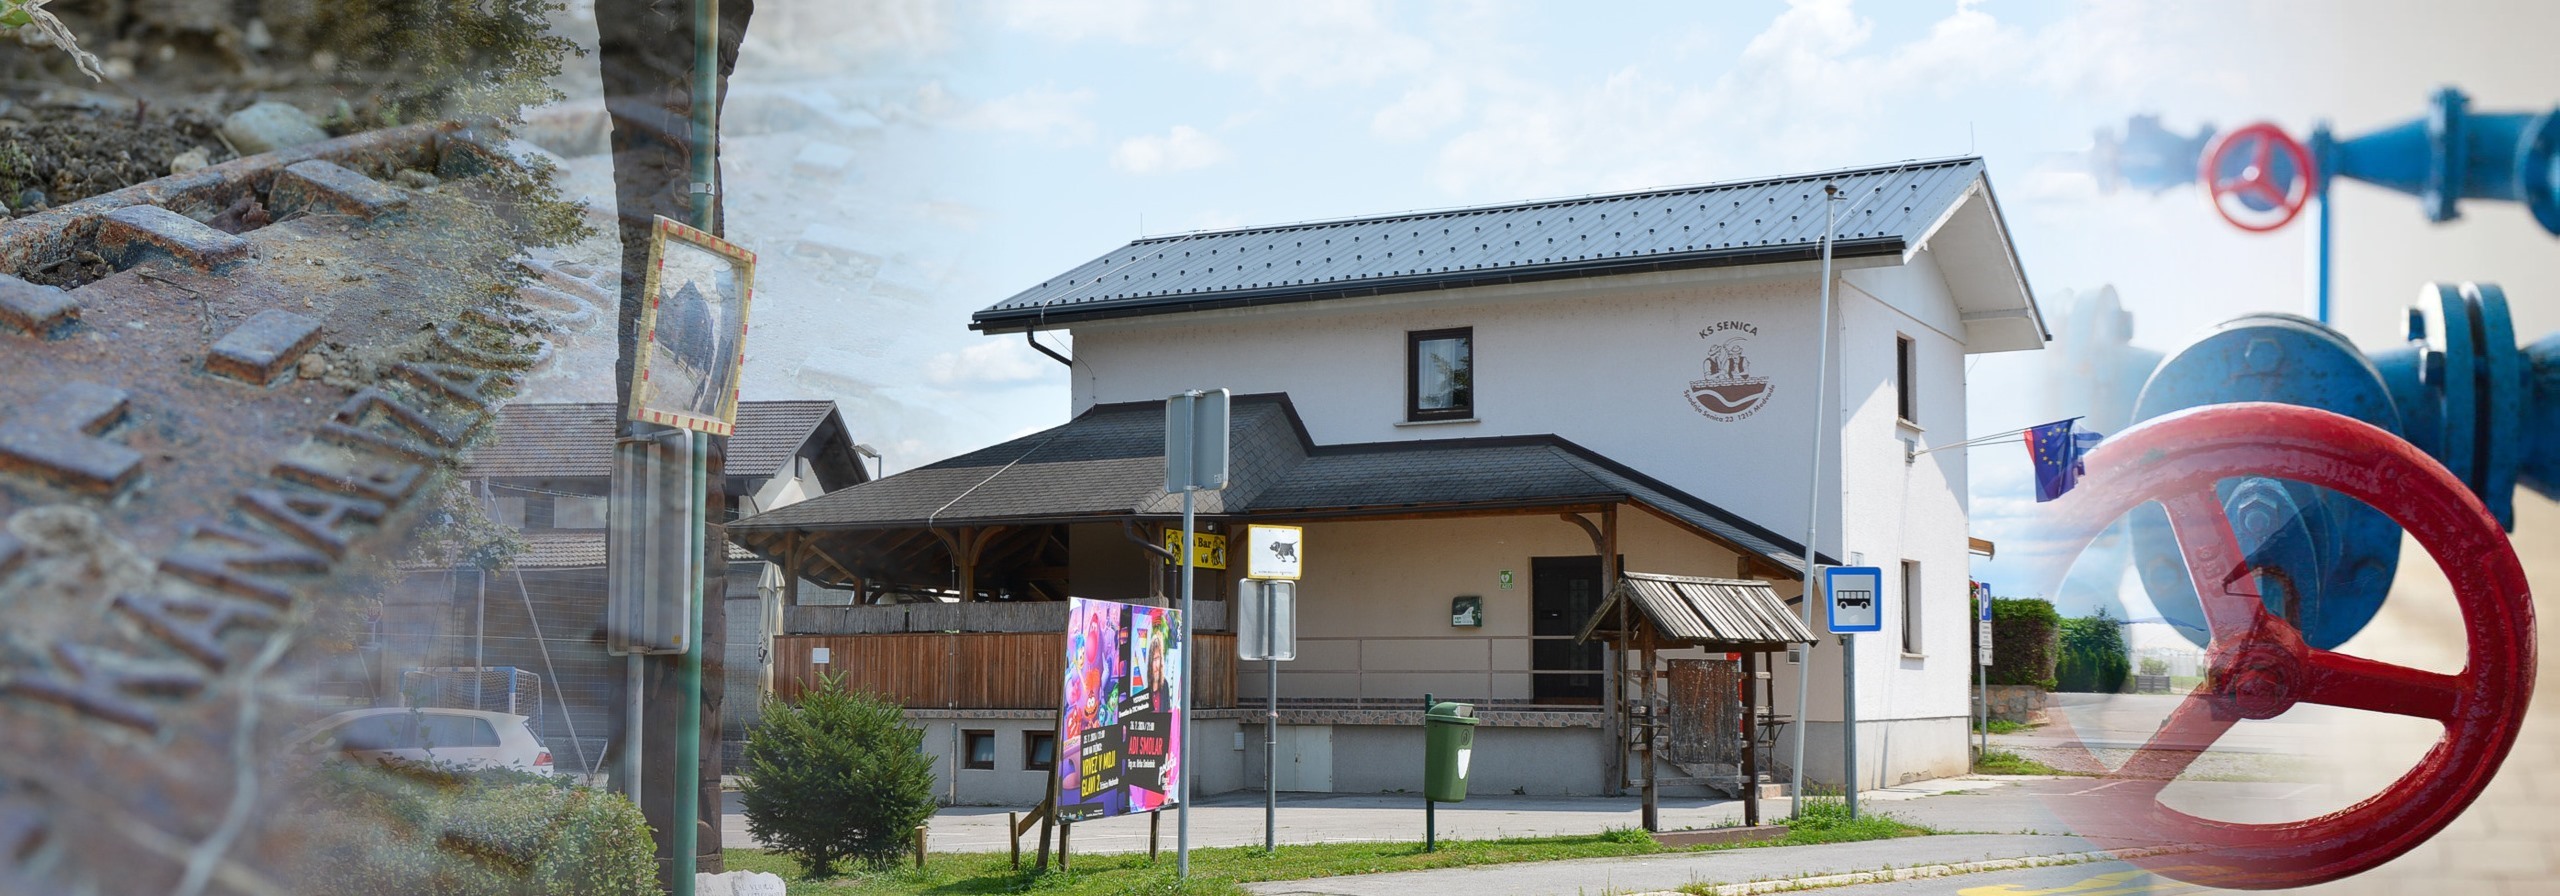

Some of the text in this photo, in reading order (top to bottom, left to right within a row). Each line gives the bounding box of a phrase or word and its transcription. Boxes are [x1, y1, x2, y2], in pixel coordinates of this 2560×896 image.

[1699, 321, 1758, 339] KS SENICA
[1683, 389, 1703, 413] Spodnja
[1703, 410, 1723, 423] Senica
[1738, 411, 1753, 421] 1215
[1198, 537, 1211, 548] Bar
[1982, 587, 1989, 616] P
[1128, 736, 1164, 756] ADI SMOLAR
